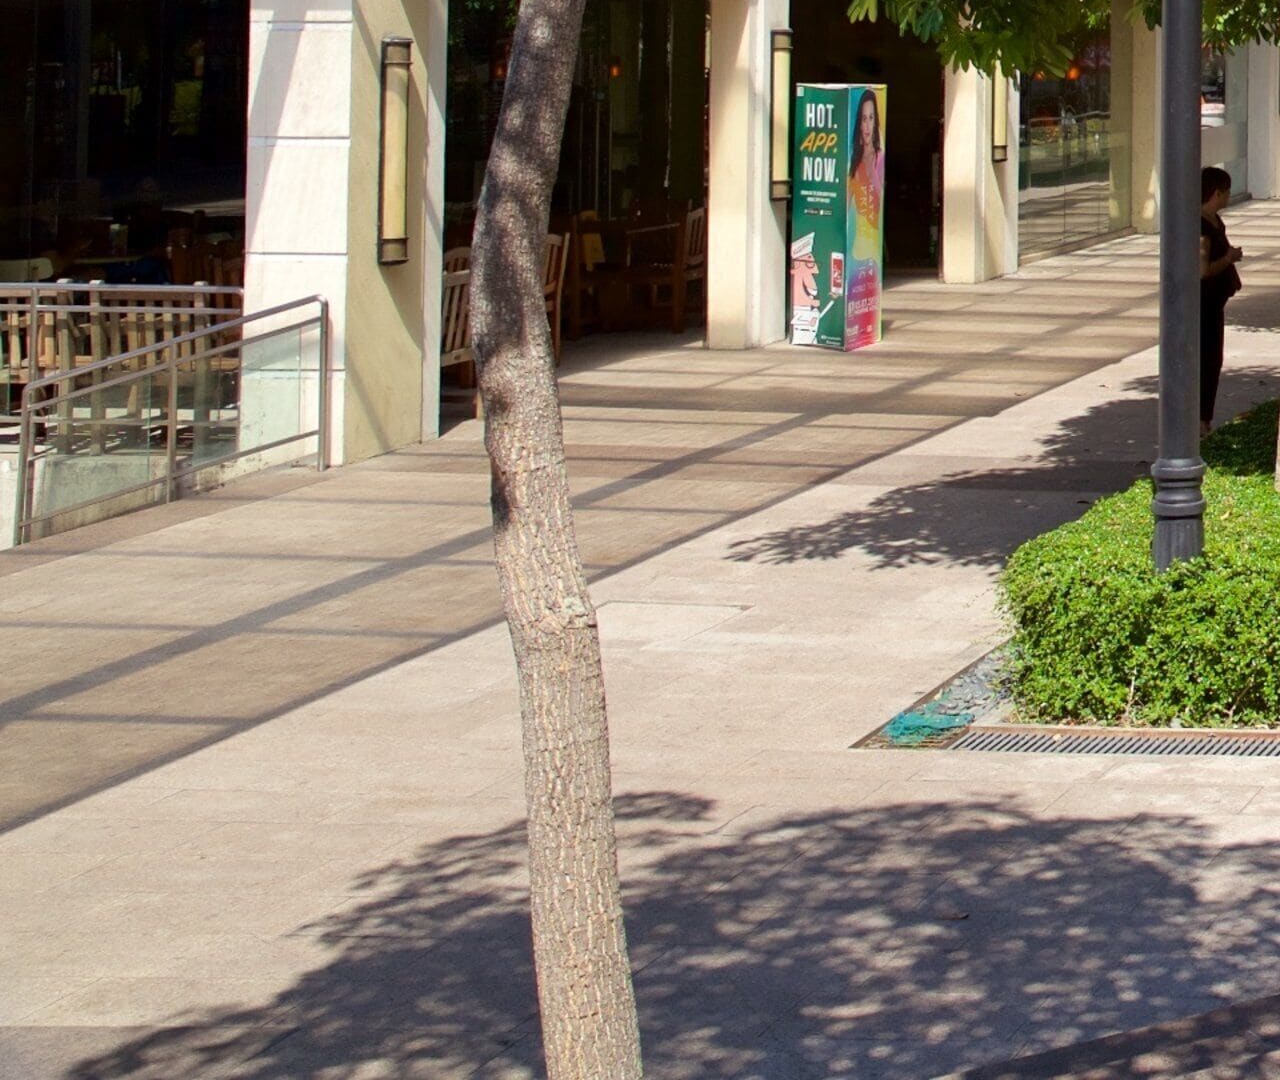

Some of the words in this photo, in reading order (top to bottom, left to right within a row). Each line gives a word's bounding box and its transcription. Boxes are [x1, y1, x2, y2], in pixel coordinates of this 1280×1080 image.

[805, 103, 838, 129] HOT.
[800, 131, 838, 154] APP.
[803, 156, 839, 183] NOW.
